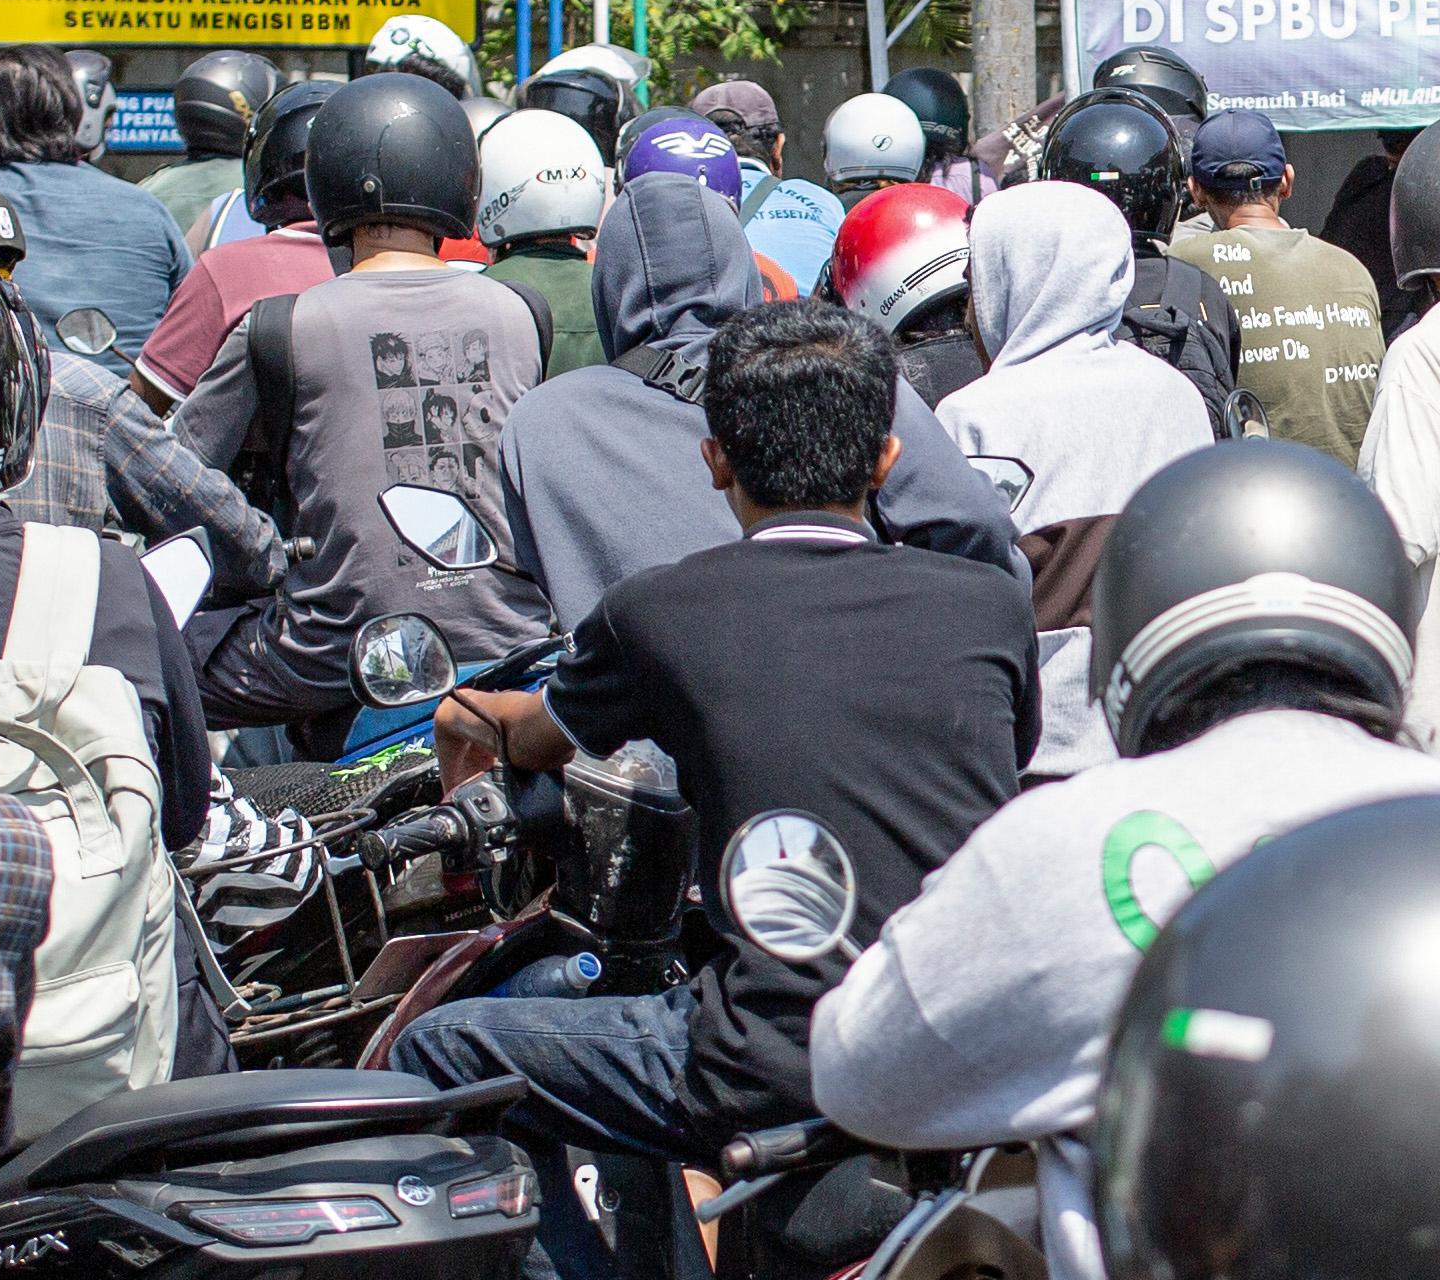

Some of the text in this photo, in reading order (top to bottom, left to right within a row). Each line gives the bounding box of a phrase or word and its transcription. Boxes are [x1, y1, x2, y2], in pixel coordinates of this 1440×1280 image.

[64, 10, 351, 31] SEWAKTU MENGISI BBM
[1301, 89, 1346, 109] Hati
[122, 112, 176, 127] PERTA
[1213, 243, 1251, 263] Ride
[1218, 273, 1254, 297] And
[1236, 302, 1371, 333] ake Family Happy
[1282, 337, 1311, 361] Die
